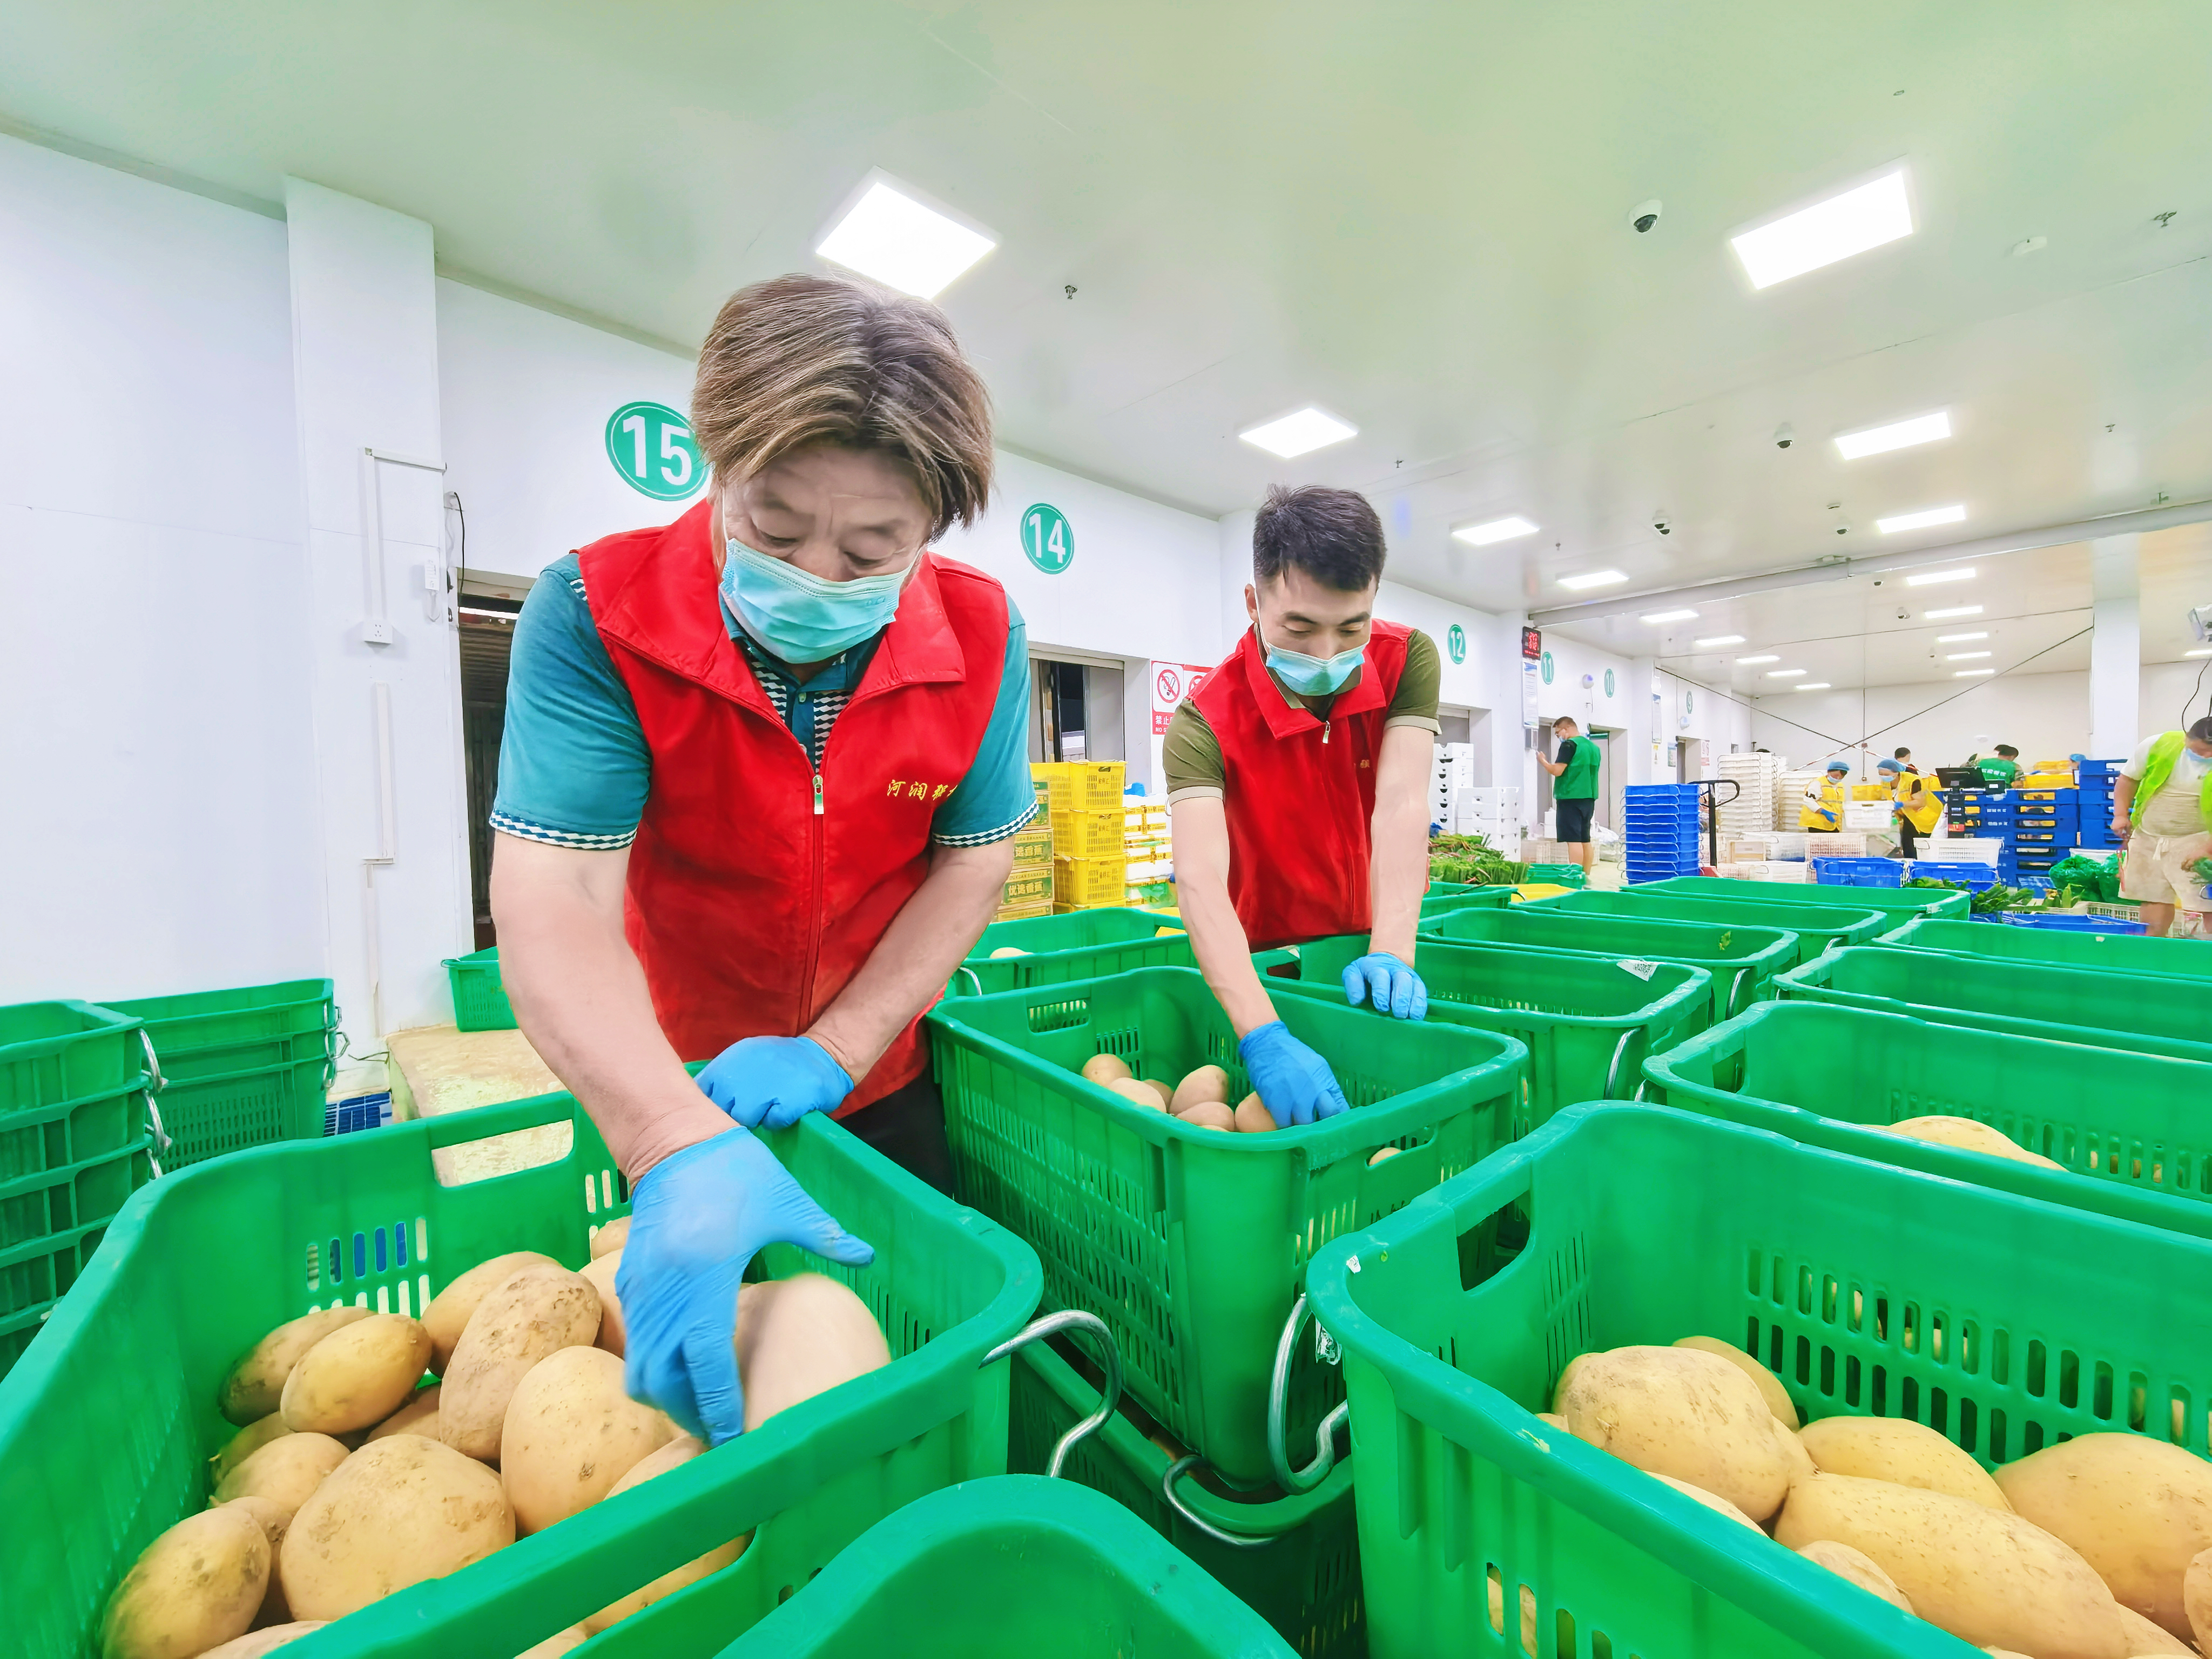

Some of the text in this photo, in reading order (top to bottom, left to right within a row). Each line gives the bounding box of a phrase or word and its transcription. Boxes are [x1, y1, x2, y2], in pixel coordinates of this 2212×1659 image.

[623, 415, 692, 485] 15
[1029, 512, 1066, 564] 14
[1451, 630, 1464, 658] 12
[1543, 657, 1552, 679] 11
[1606, 673, 1613, 693] 10
[1155, 715, 1172, 725] 禁止
[1015, 845, 1043, 857] 选香蕉
[1008, 881, 1043, 896] 优选香蕉
